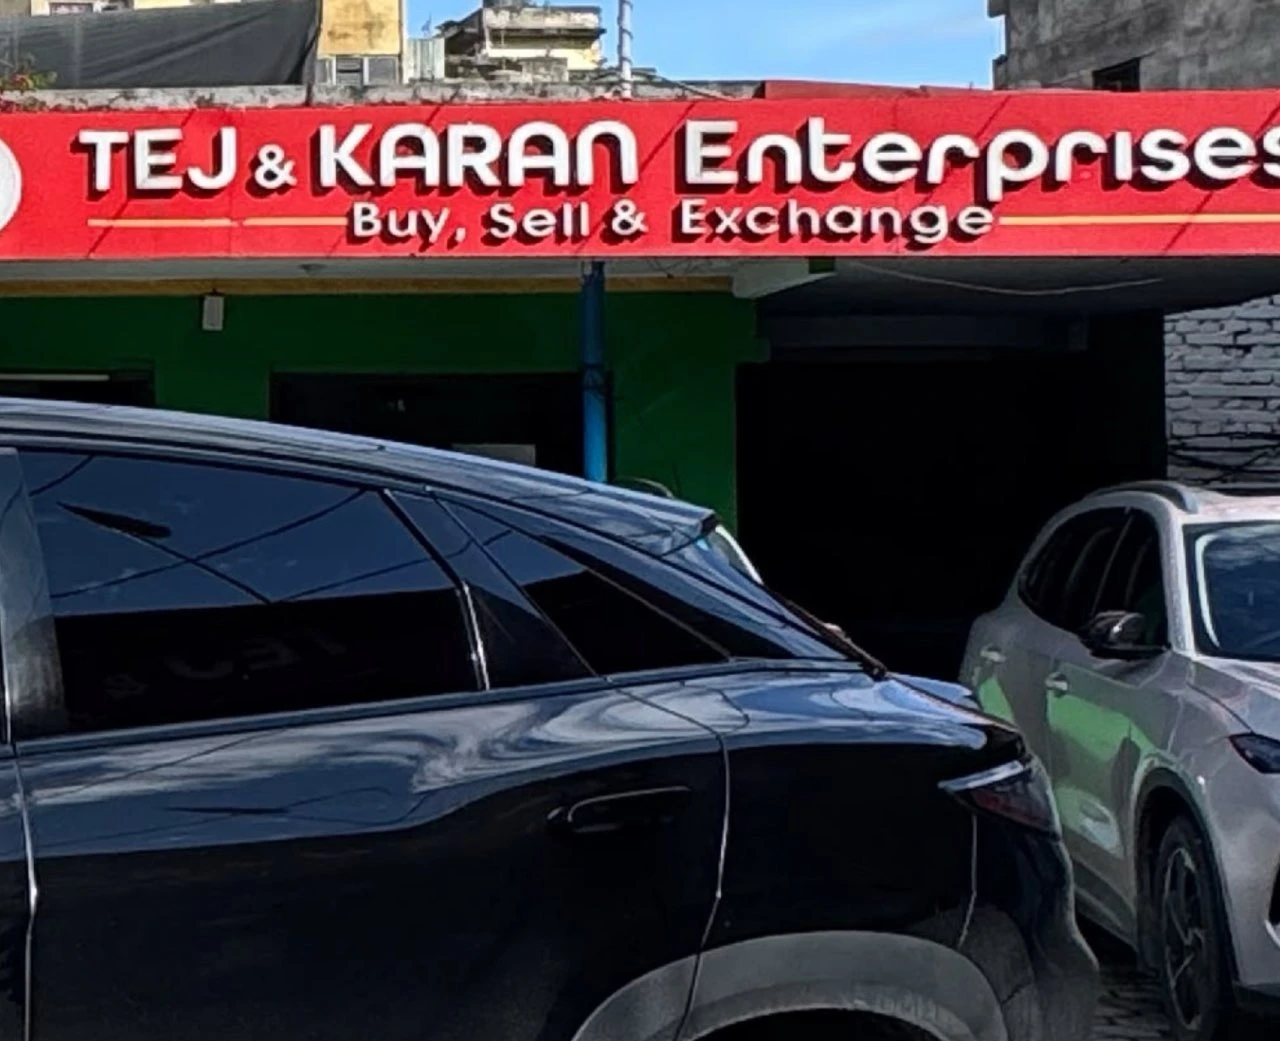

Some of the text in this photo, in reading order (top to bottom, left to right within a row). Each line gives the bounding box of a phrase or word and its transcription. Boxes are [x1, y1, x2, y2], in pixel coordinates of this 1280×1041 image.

[78, 125, 238, 192] TEJ
[253, 143, 298, 190] &
[319, 118, 638, 188] KARAN
[352, 198, 995, 243] Buy, Sell & Exchange
